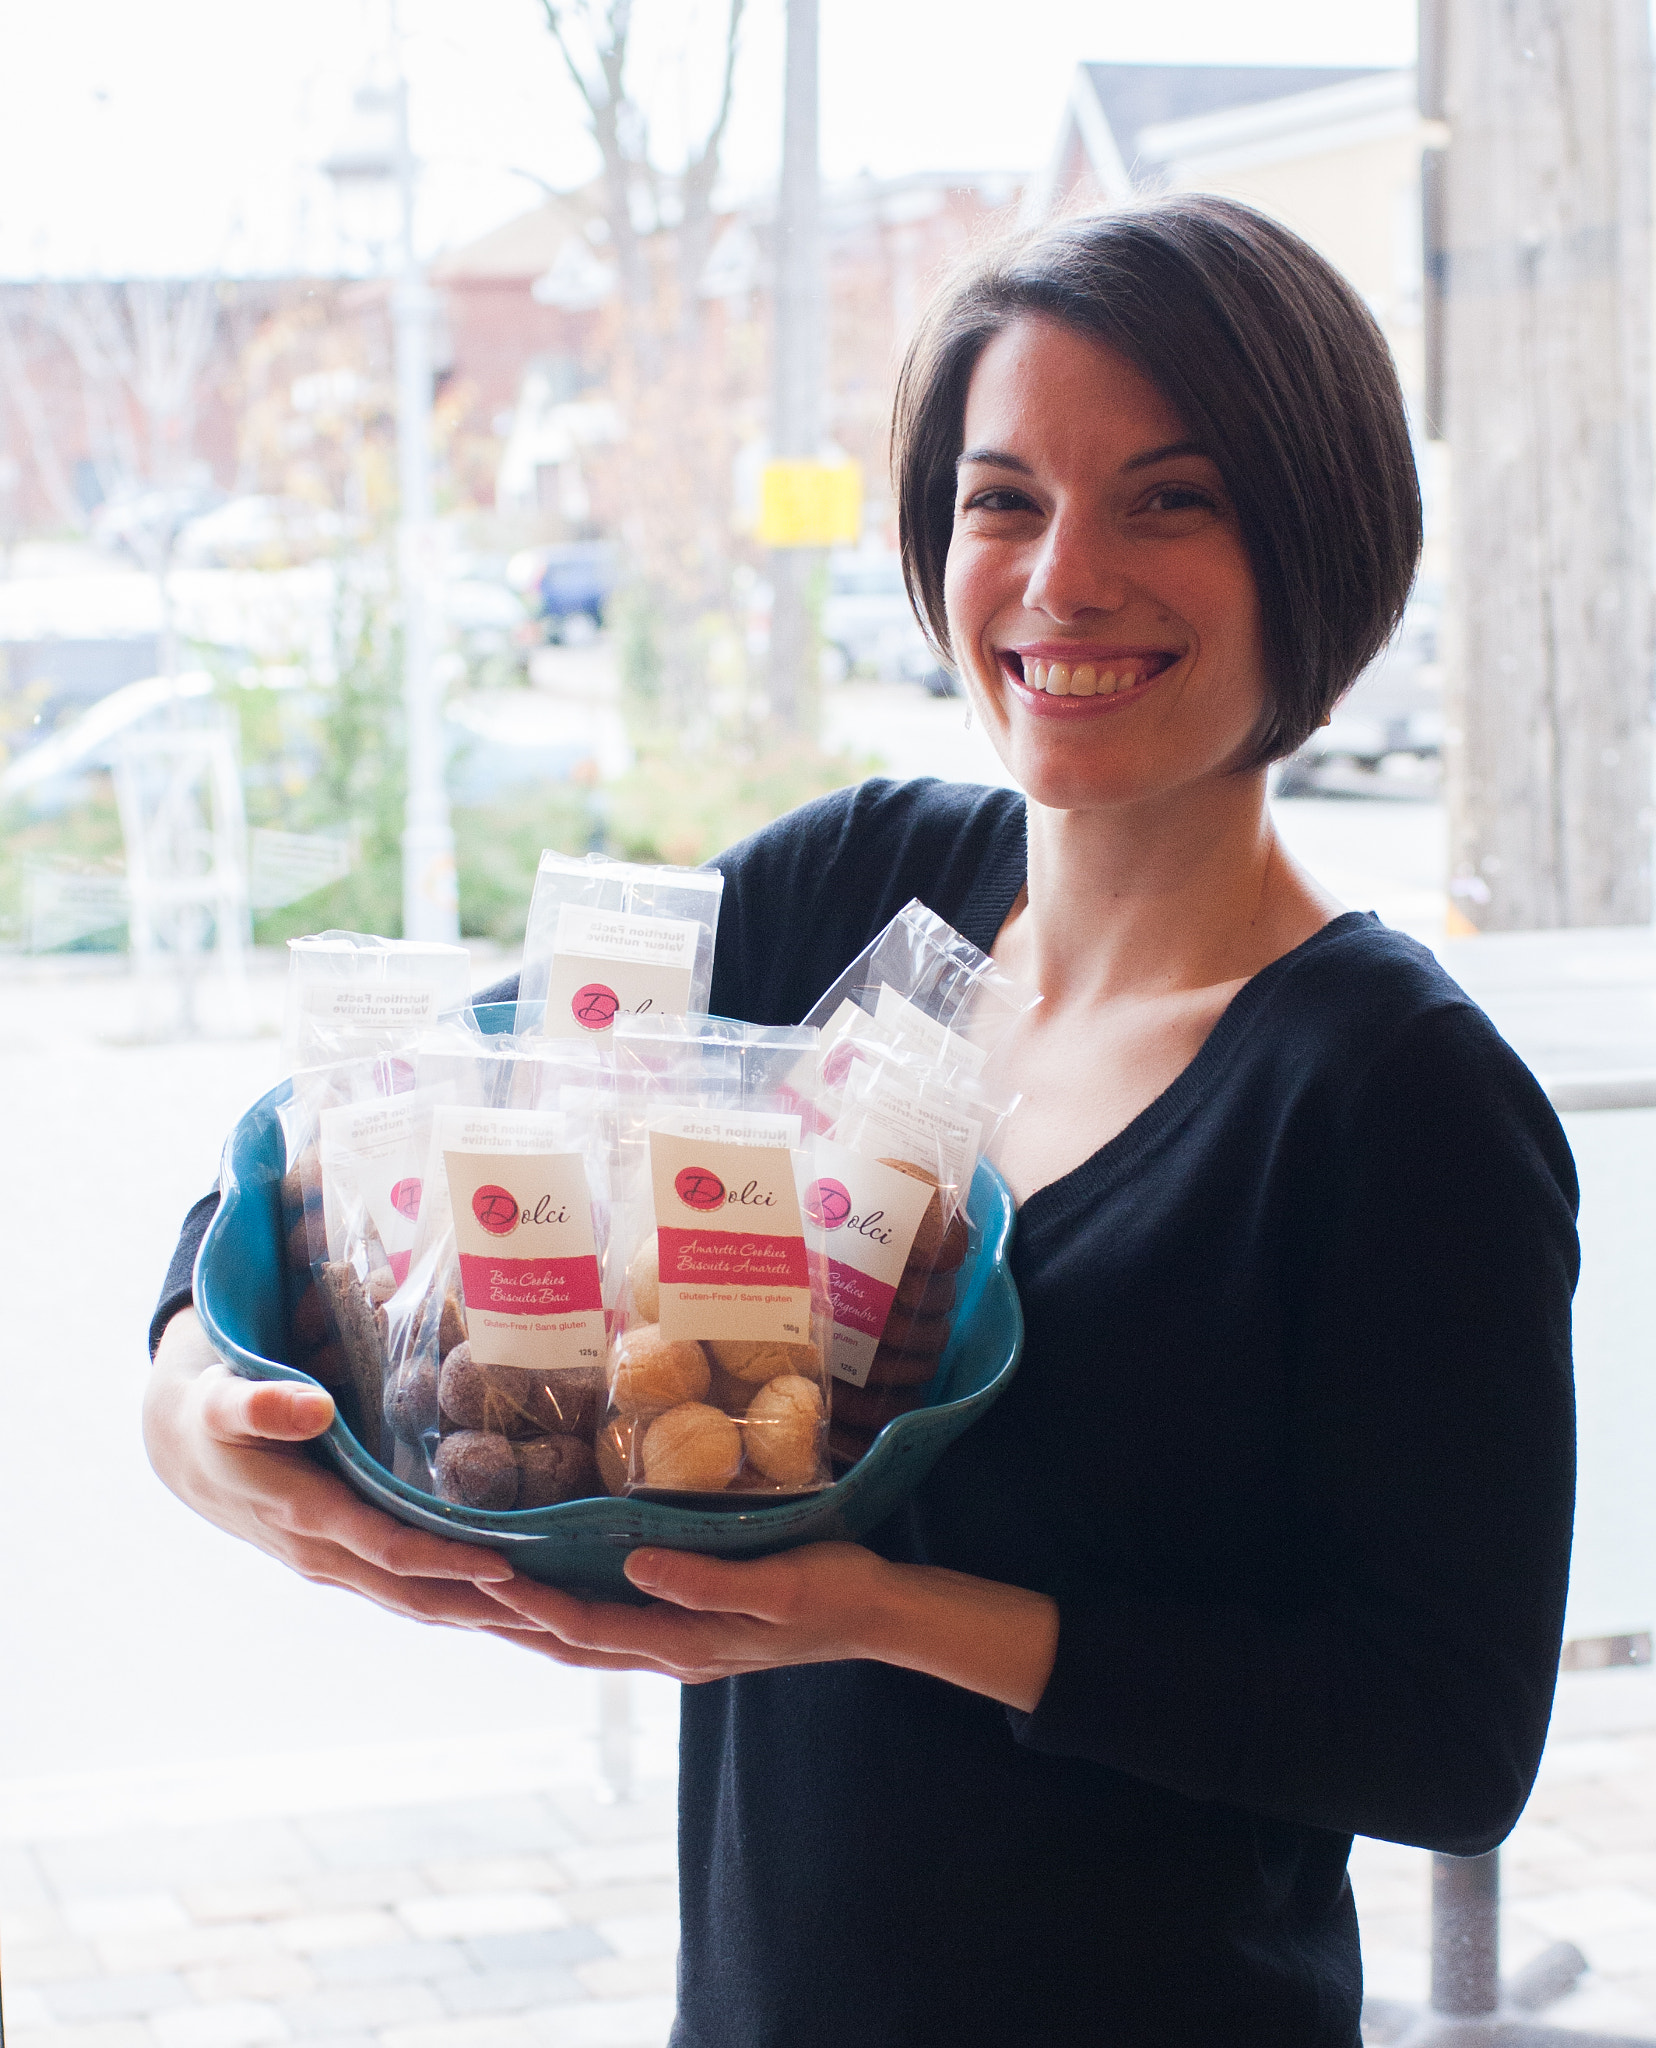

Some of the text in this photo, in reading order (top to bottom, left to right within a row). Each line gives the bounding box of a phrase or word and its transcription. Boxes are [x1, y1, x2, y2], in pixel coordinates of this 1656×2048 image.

[683, 1175, 777, 1207] Dolci
[480, 1194, 571, 1226] Dolci
[806, 1186, 893, 1245] Dolci
[679, 1239, 787, 1259] Amaretti Cookies
[676, 1254, 792, 1275] Biscuits Amaretti
[490, 1269, 566, 1287] Baci Cookies
[827, 1271, 865, 1298] Cookies
[490, 1286, 570, 1304] Biscuits Baci
[679, 1291, 733, 1301] Gluten-Free
[740, 1293, 763, 1303] Sans
[764, 1293, 793, 1304] gluten
[483, 1318, 528, 1331] Gluten-Free
[535, 1322, 557, 1332] Sans
[558, 1320, 587, 1332] gluten
[833, 1332, 858, 1347] gluten
[578, 1348, 598, 1358] 125g
